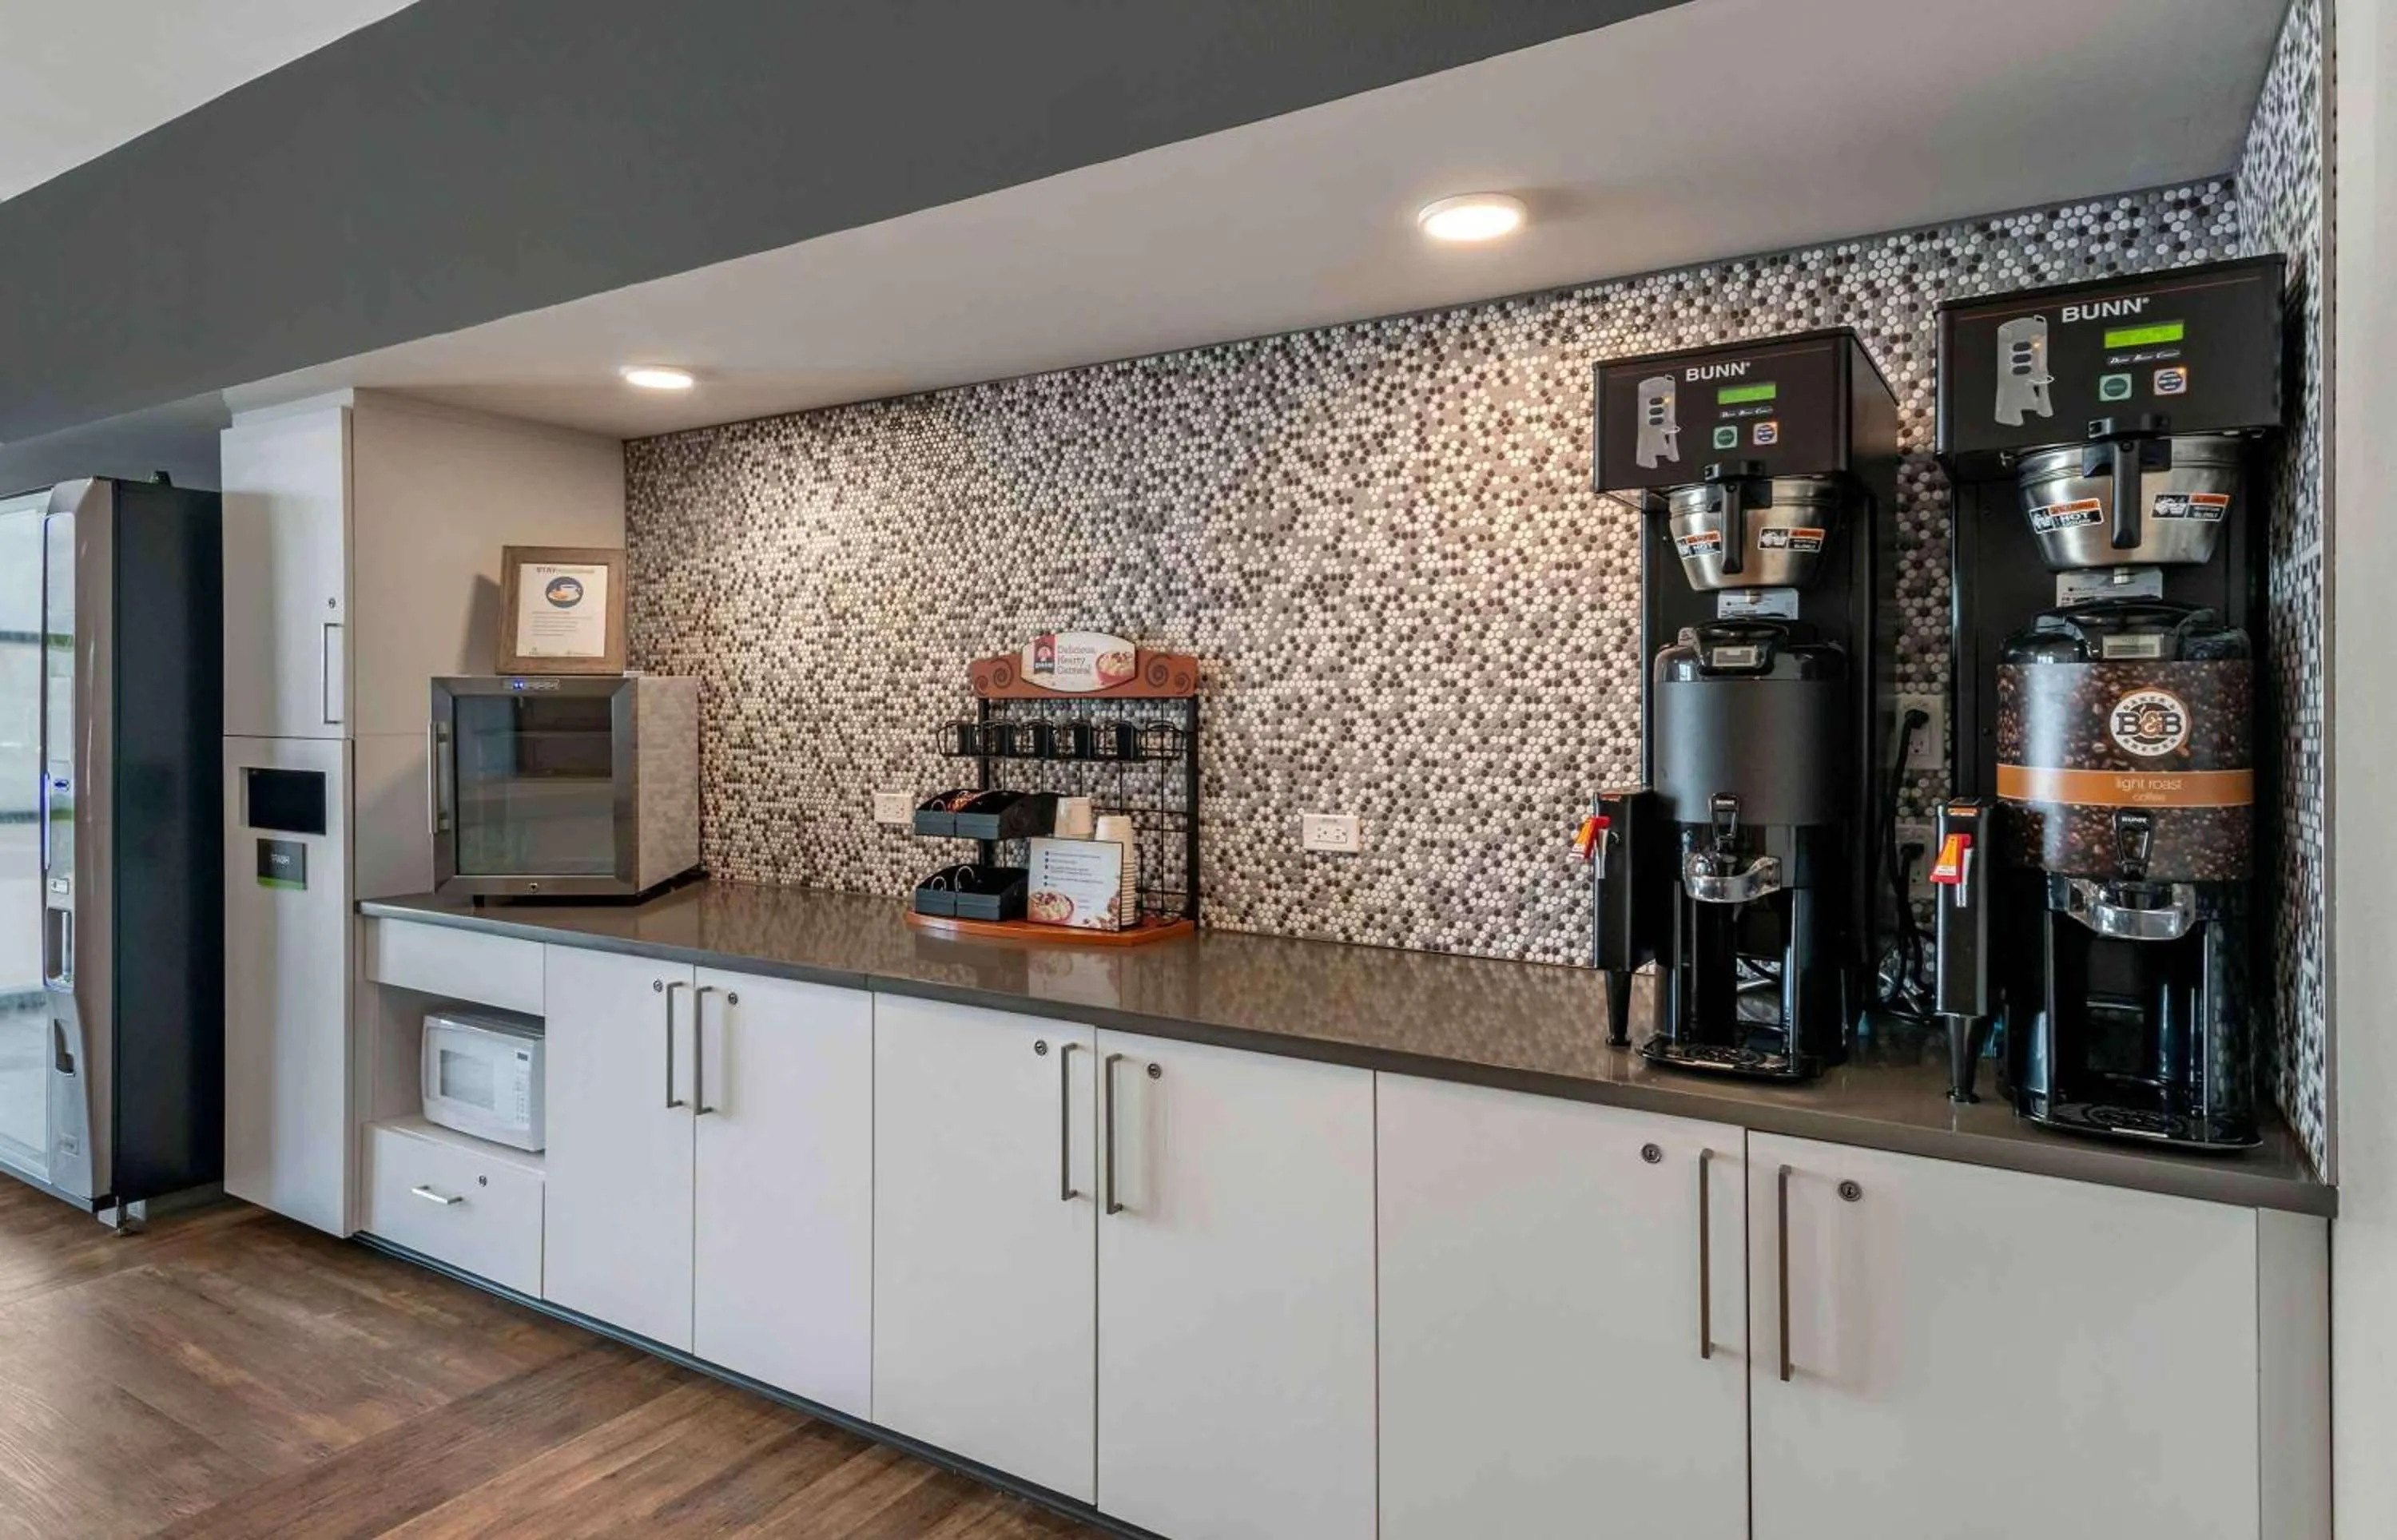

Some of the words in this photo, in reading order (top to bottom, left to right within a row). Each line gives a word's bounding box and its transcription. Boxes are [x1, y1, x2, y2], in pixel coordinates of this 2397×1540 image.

[2116, 710, 2182, 737] B&B
[2115, 776, 2145, 792] light
[2148, 778, 2183, 791] roast
